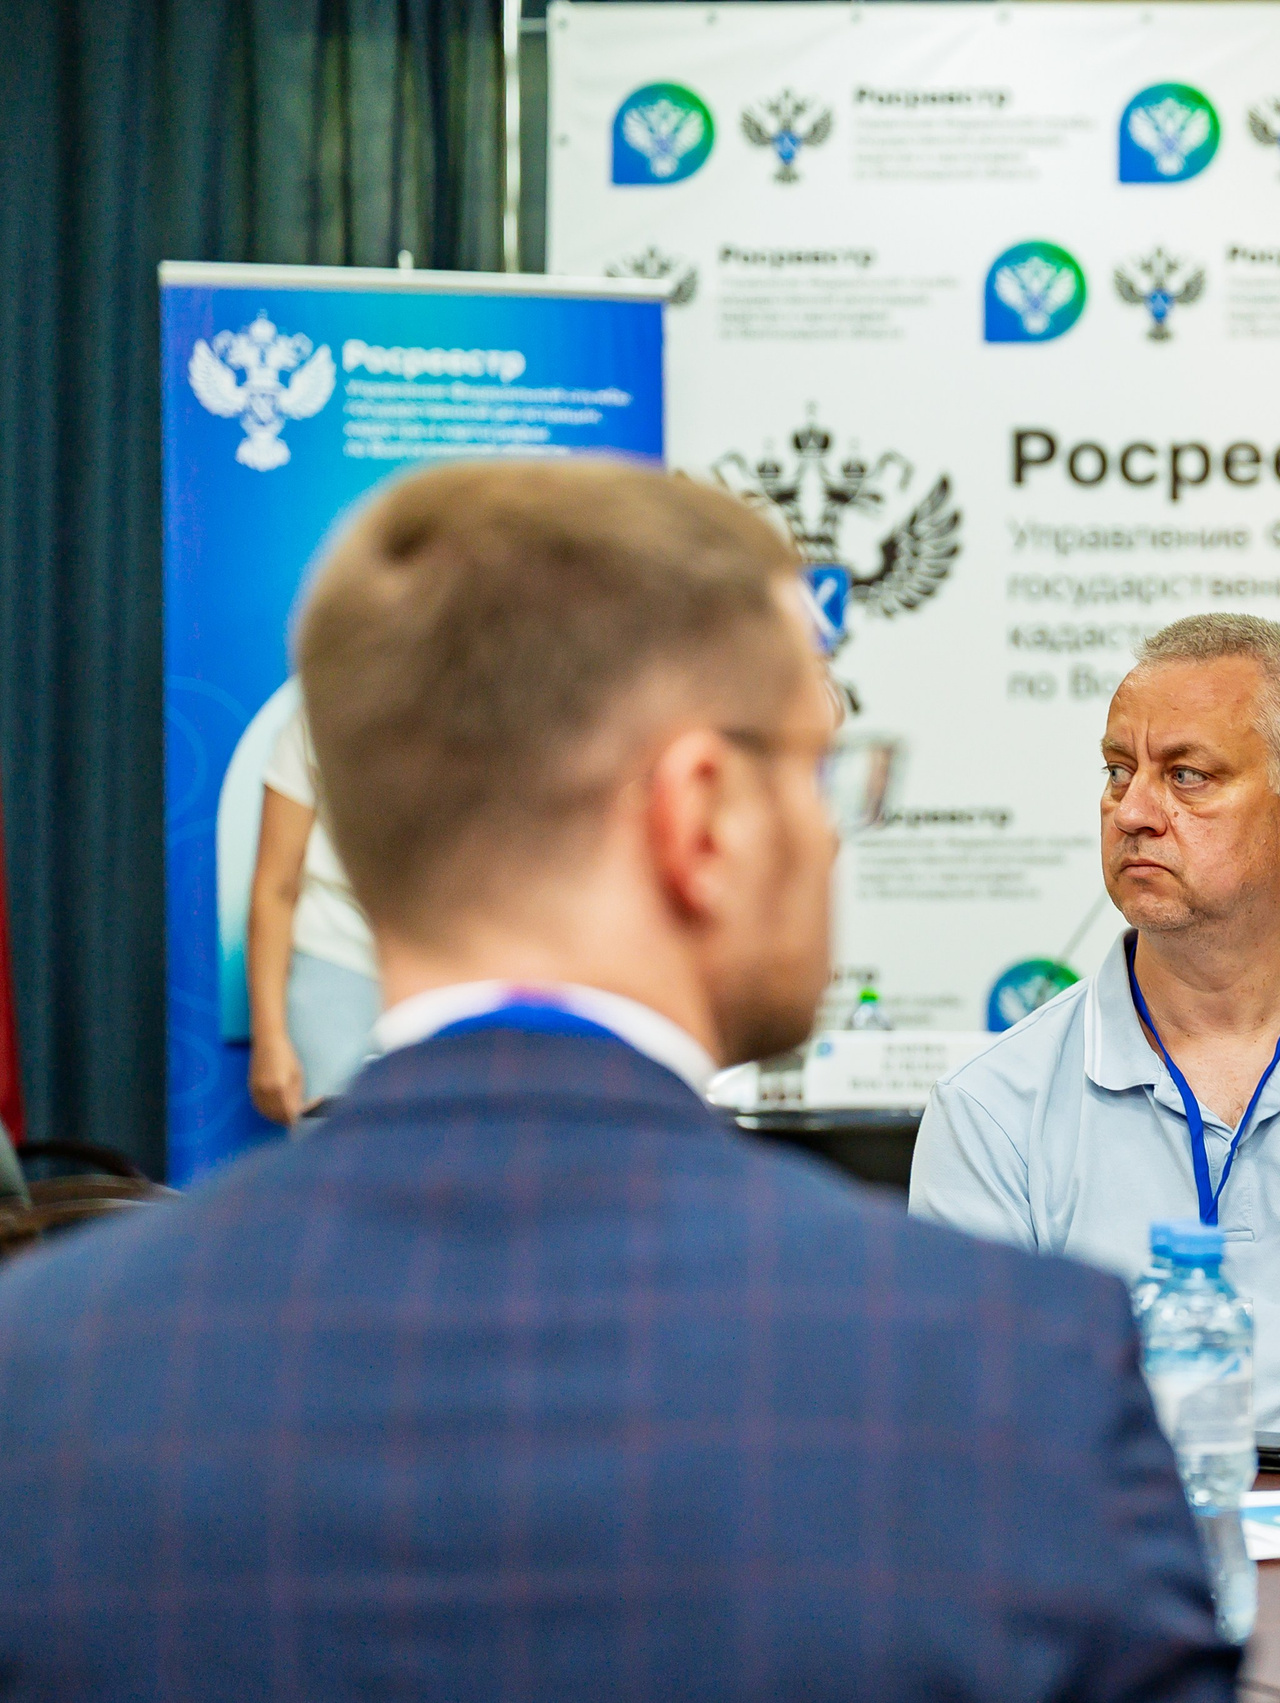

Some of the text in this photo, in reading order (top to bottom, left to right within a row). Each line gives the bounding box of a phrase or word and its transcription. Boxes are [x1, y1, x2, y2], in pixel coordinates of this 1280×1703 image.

[1008, 518, 1250, 556] Управление
[1007, 622, 1155, 652] кадаст
[1007, 672, 1056, 698] по
